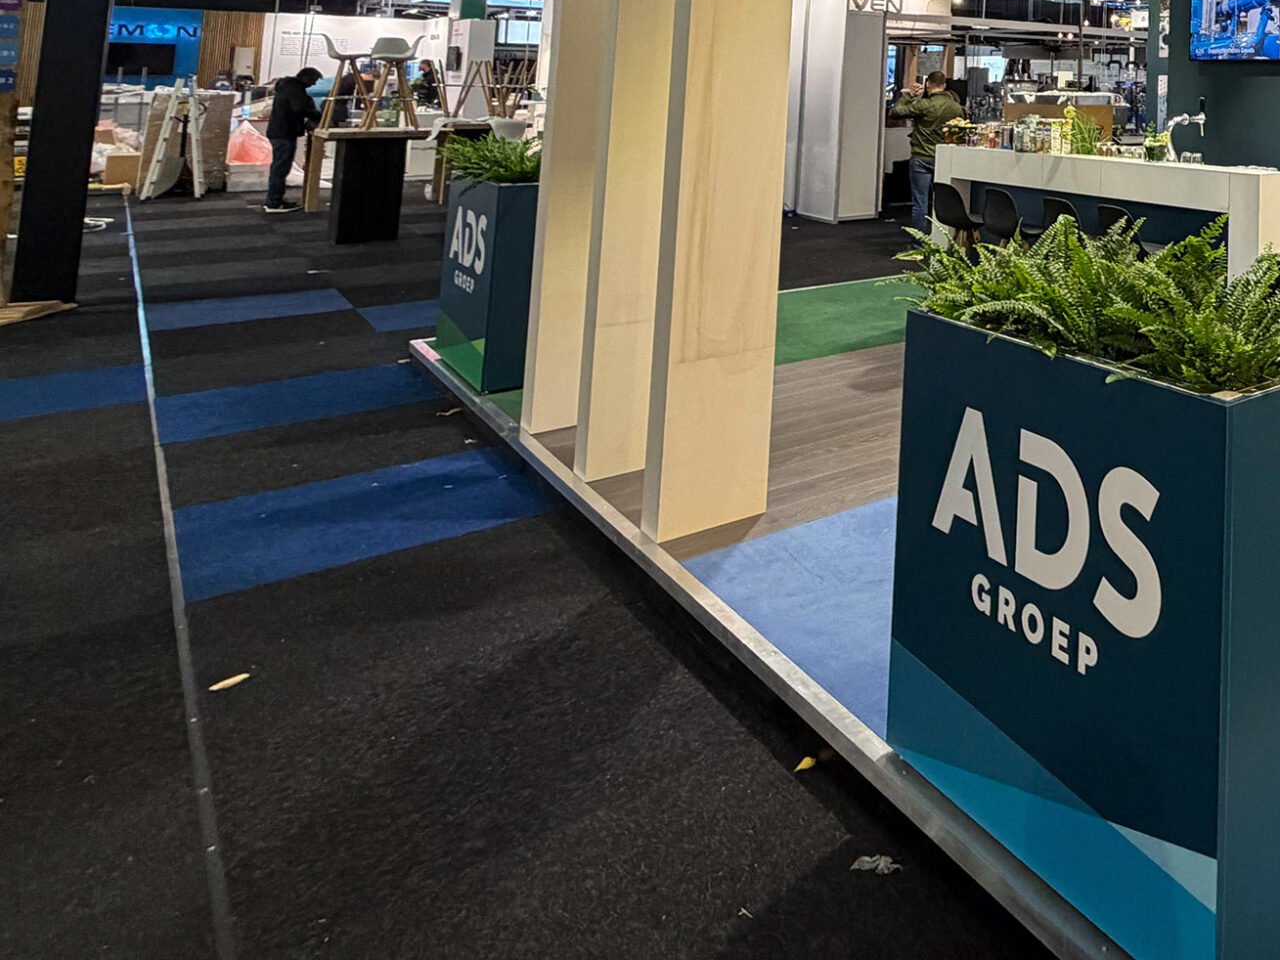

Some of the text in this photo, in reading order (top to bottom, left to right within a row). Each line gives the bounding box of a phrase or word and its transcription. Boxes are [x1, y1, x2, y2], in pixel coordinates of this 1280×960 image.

[449, 205, 488, 275] ADS
[454, 269, 475, 294] GROEP
[931, 406, 1162, 638] ADS
[971, 573, 1098, 675] GROEP
